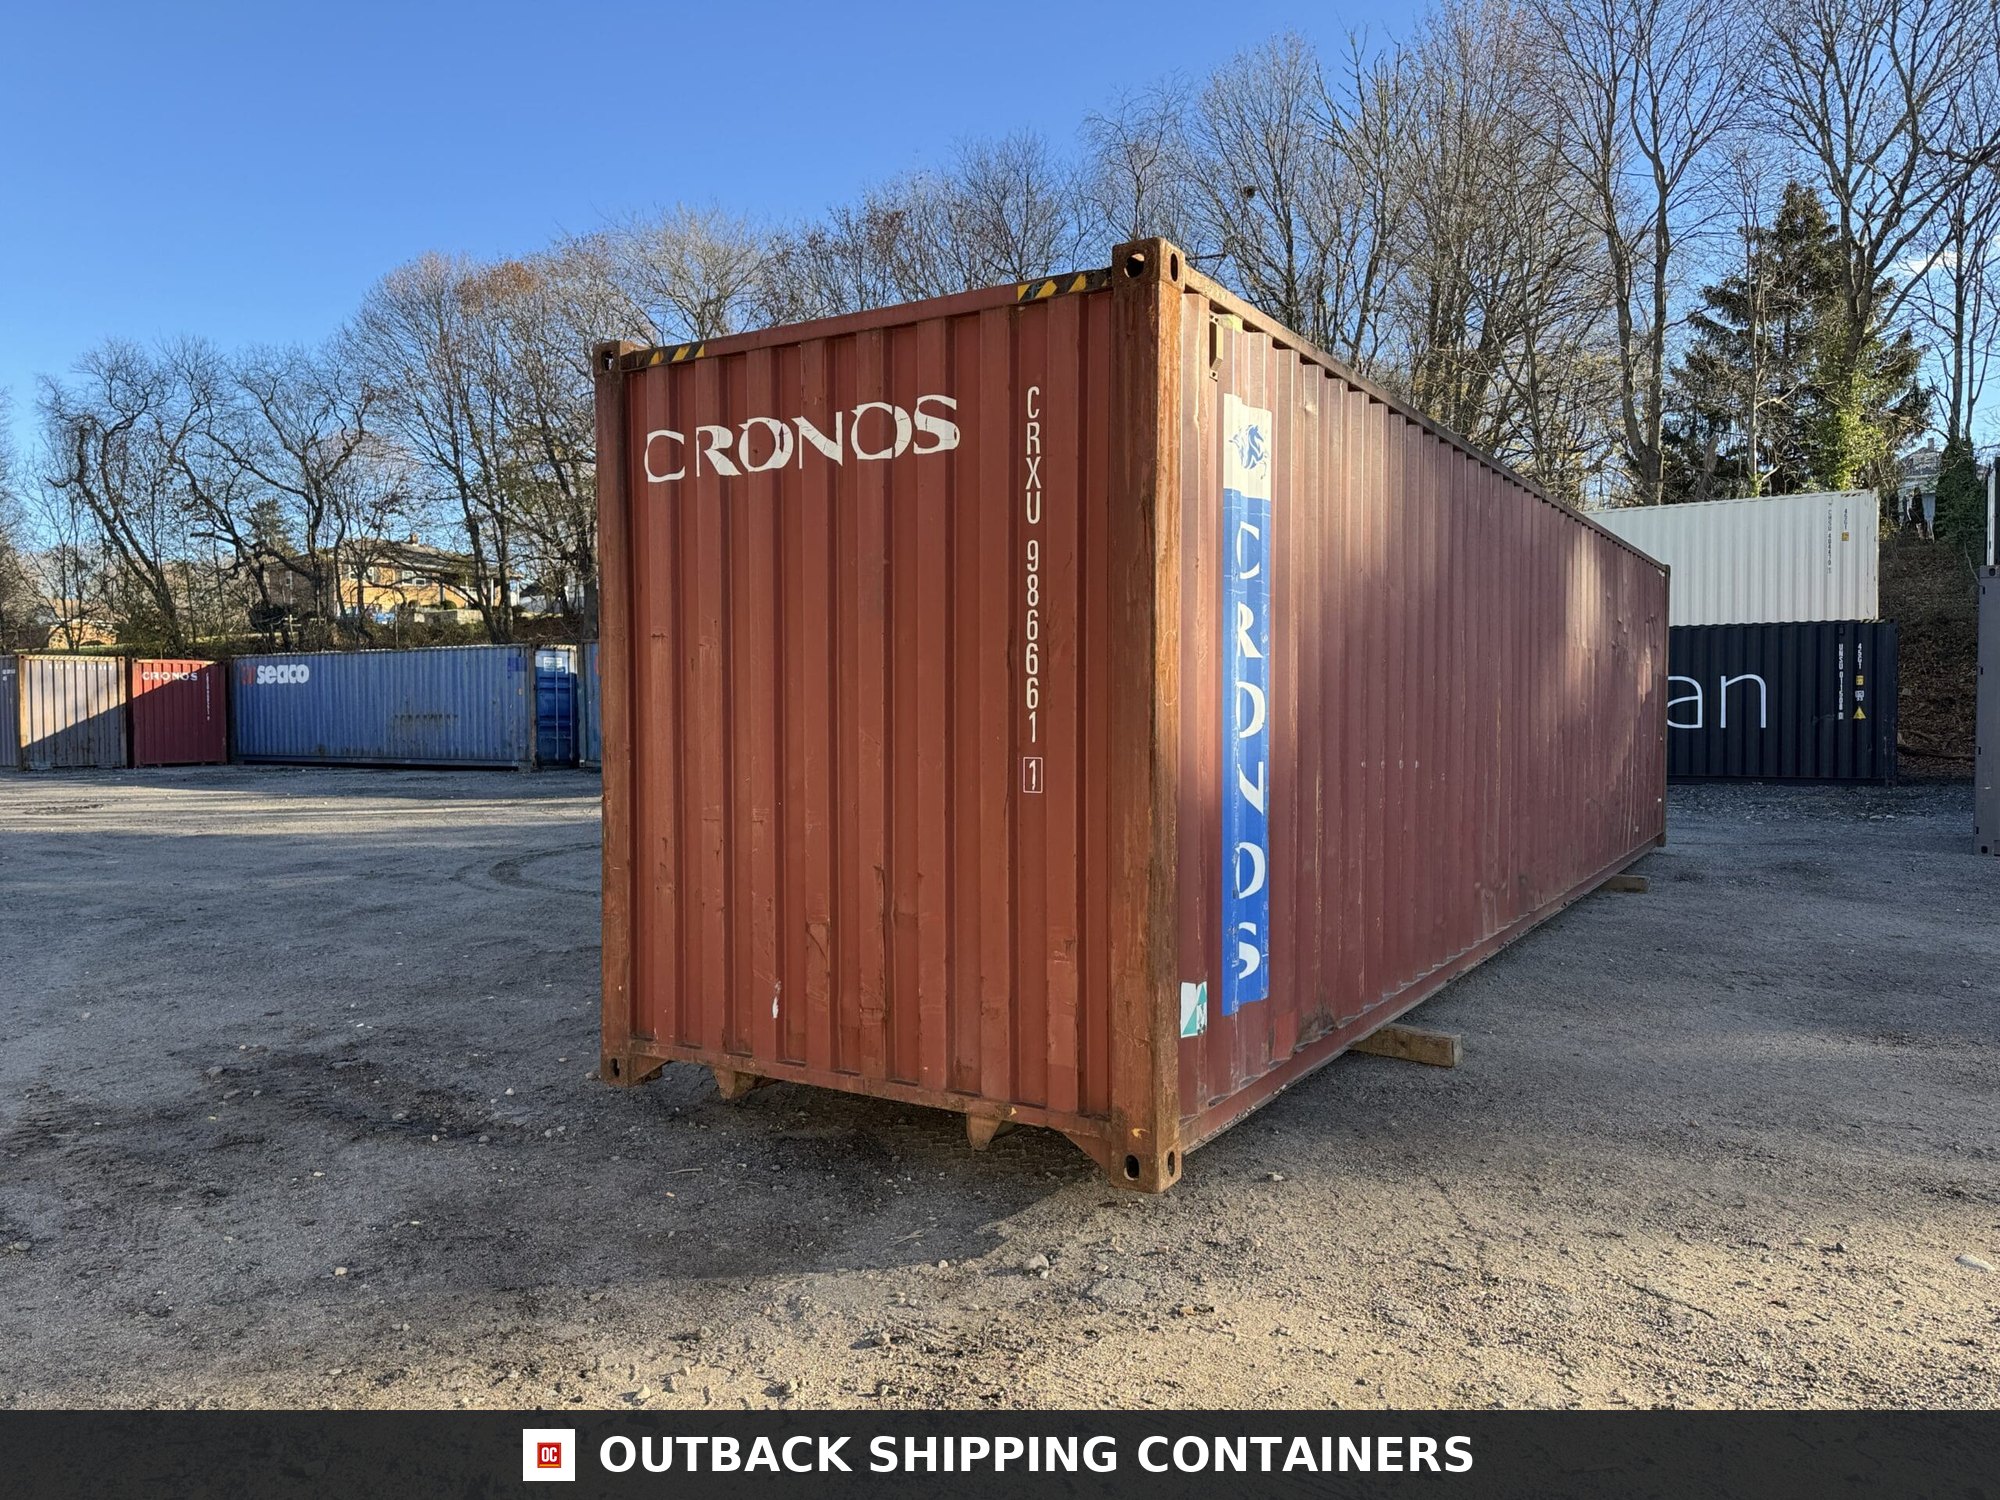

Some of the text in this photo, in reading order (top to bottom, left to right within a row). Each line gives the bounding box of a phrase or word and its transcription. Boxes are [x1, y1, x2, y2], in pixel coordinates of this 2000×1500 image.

[644, 394, 961, 483] CRONOS
[1025, 386, 1042, 525] CRXU
[142, 671, 198, 681] CRONOS
[257, 664, 310, 684] seaco
[1025, 540, 1040, 744] 986661
[1666, 673, 1767, 729] an
[1235, 520, 1266, 980] CRONOS
